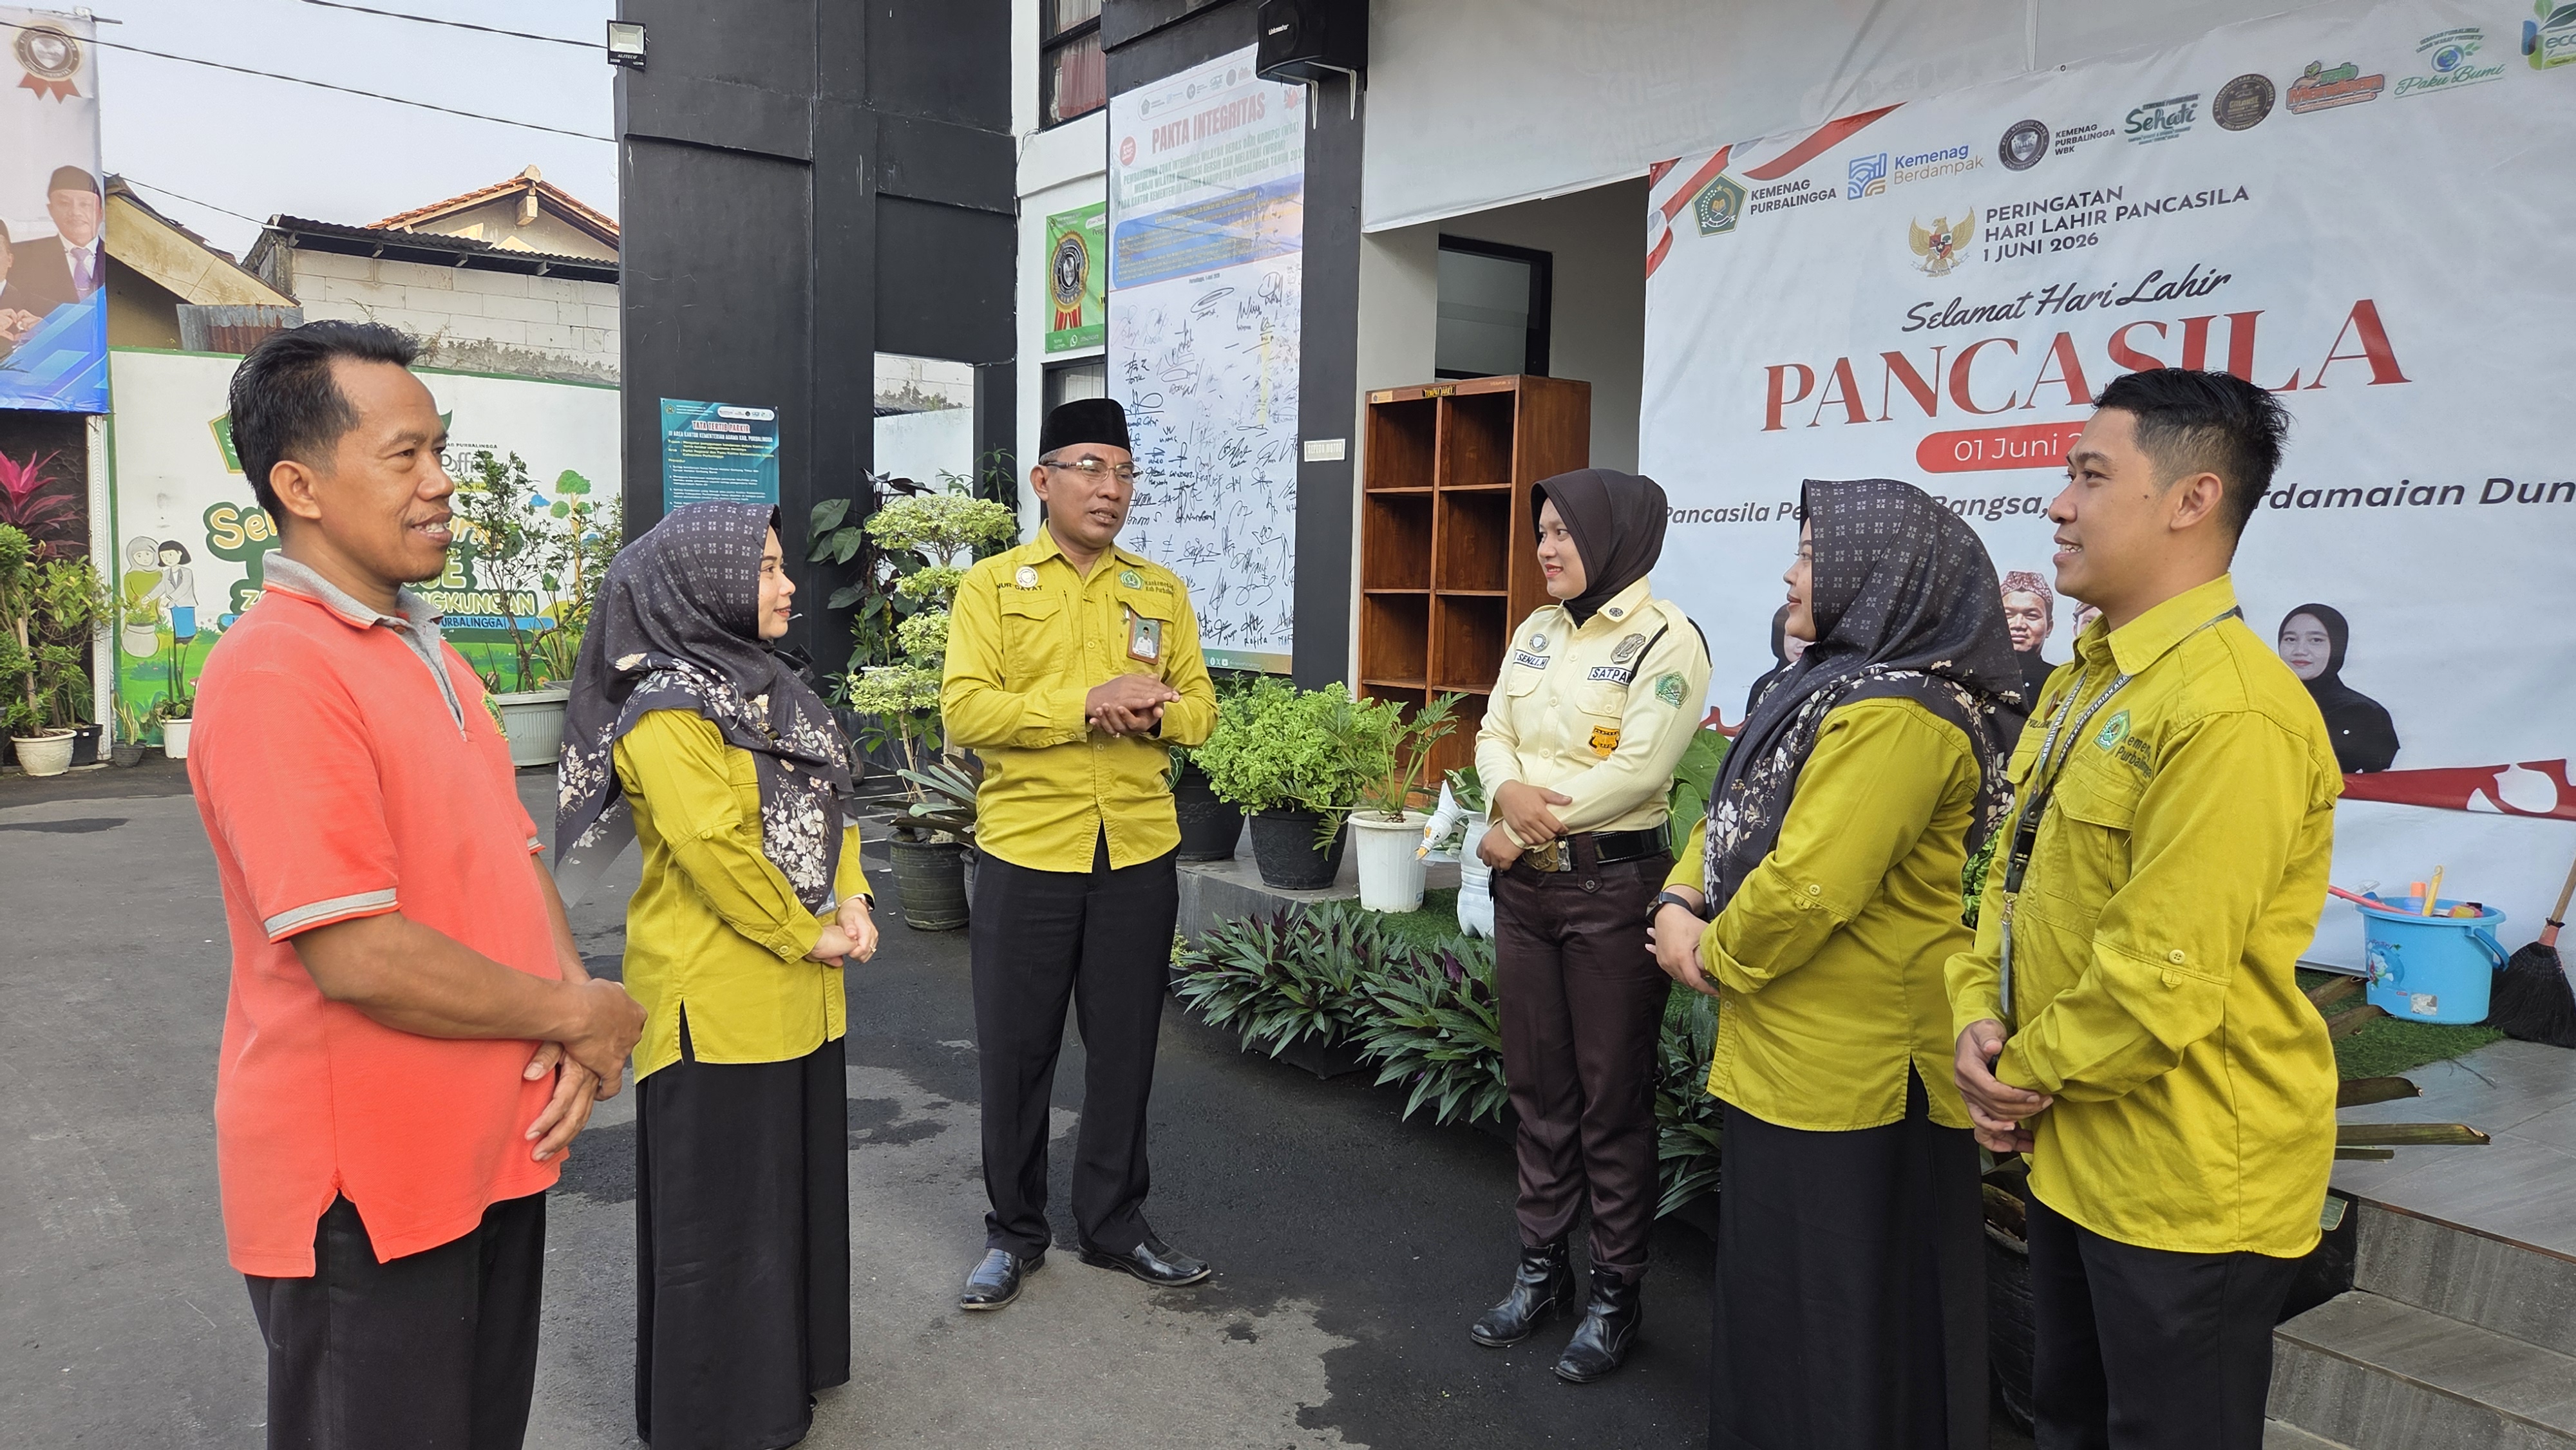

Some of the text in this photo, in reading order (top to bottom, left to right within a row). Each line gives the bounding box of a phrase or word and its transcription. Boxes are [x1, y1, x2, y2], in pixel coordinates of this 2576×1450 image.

[2394, 64, 2506, 95] Paku Bumi
[1152, 118, 1189, 154] PAKTA
[1193, 91, 1265, 141] INTEGRITAS
[2056, 124, 2098, 138] KEMENAG
[2125, 103, 2198, 134] Sehati
[2054, 146, 2075, 156] WBK
[2055, 129, 2115, 147] PURBALINGGA
[1893, 155, 1984, 185] Berdampak
[1895, 145, 1969, 169] Kemenag
[1750, 188, 1837, 214] PURBALINGGA
[1751, 179, 1811, 201] KEMENAG
[1986, 185, 2123, 223] PERINGATAN
[1985, 185, 2249, 243] HARI LAHIR PANCASILA
[1984, 232, 2099, 263] 1 JUNI 2026
[1902, 263, 2232, 332] Selamat Hari Lahir
[1761, 298, 2412, 431] PANCASILA
[692, 421, 750, 433] TATA TERTIB PARKIR
[1955, 439, 1983, 461] 01
[1991, 432, 2058, 459] Juni
[1776, 502, 1801, 522] Pe
[2254, 479, 2466, 510] rdamaian
[442, 617, 504, 628] URBALINGGA
[2074, 688, 2114, 735] KEMENTERIAN
[2113, 674, 2129, 690] AGA
